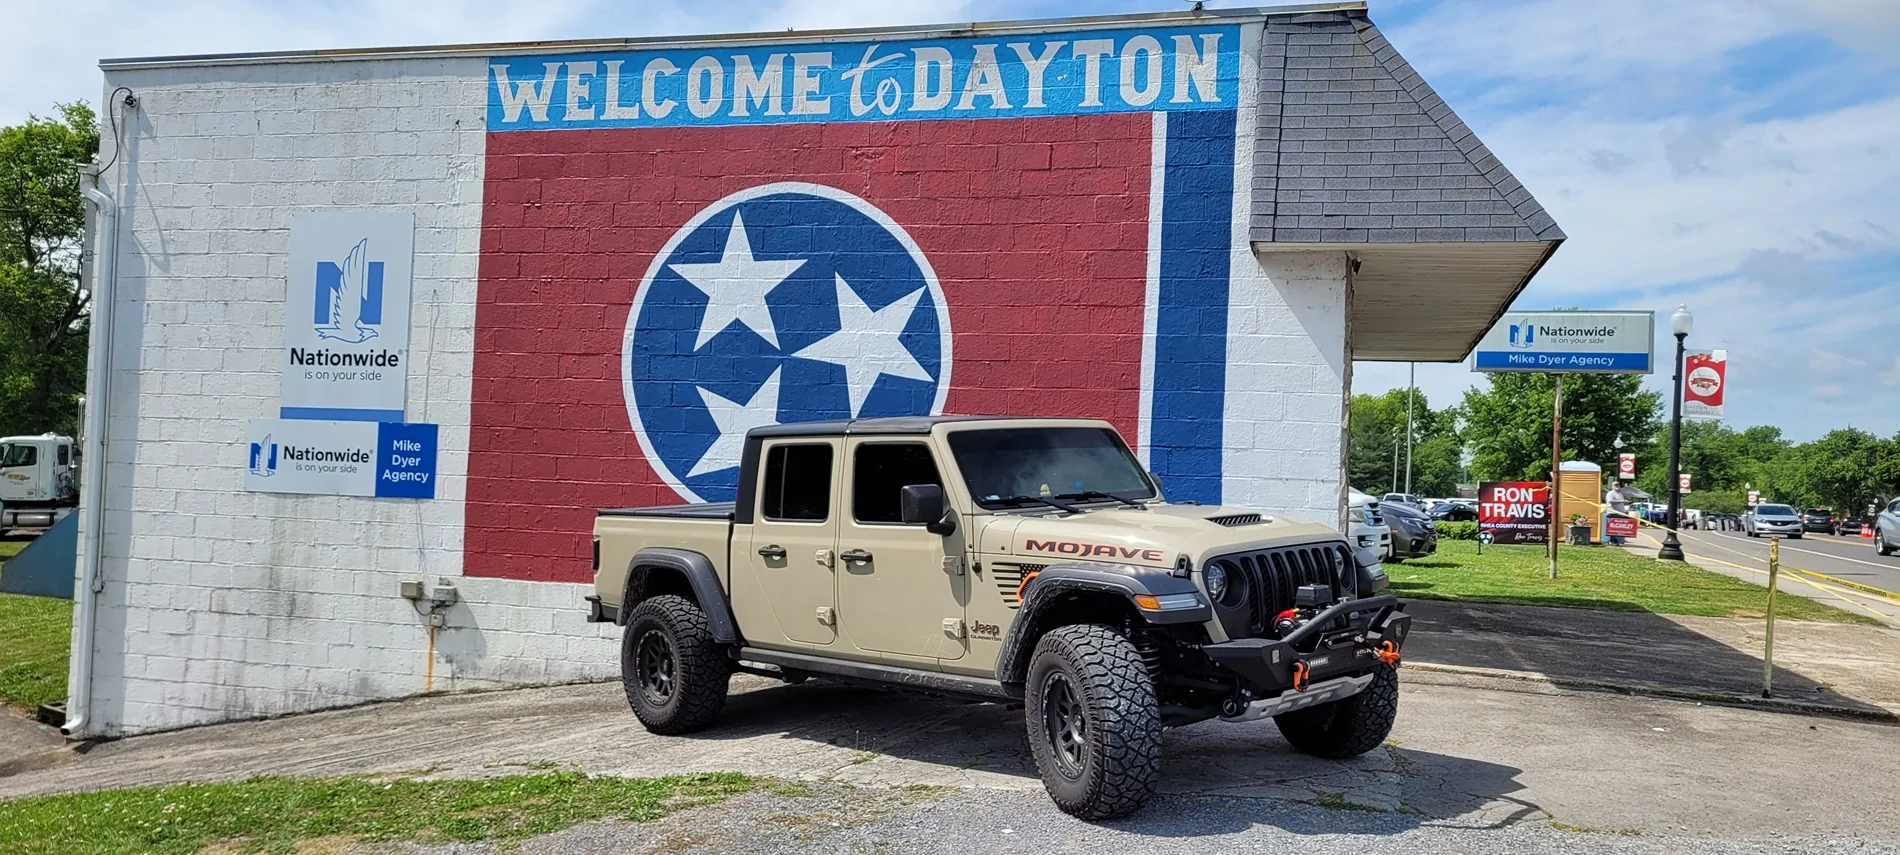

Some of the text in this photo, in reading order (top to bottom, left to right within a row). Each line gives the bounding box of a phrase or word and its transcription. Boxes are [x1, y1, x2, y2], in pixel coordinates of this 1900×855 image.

[490, 33, 1224, 123] WELCOME to DAYTON
[1509, 354, 1615, 366] Mike Dyer Agency
[304, 369, 382, 382] is on your side
[393, 440, 422, 452] Mike
[391, 454, 421, 467] Dyer
[295, 463, 303, 472] is
[318, 465, 337, 475] your
[340, 464, 358, 474] side
[382, 468, 429, 484] Agency
[1493, 487, 1533, 502] RON
[1481, 503, 1545, 519] TRAVIS
[1025, 539, 1165, 562] MOJAVE
[970, 619, 1000, 637] Jeep
